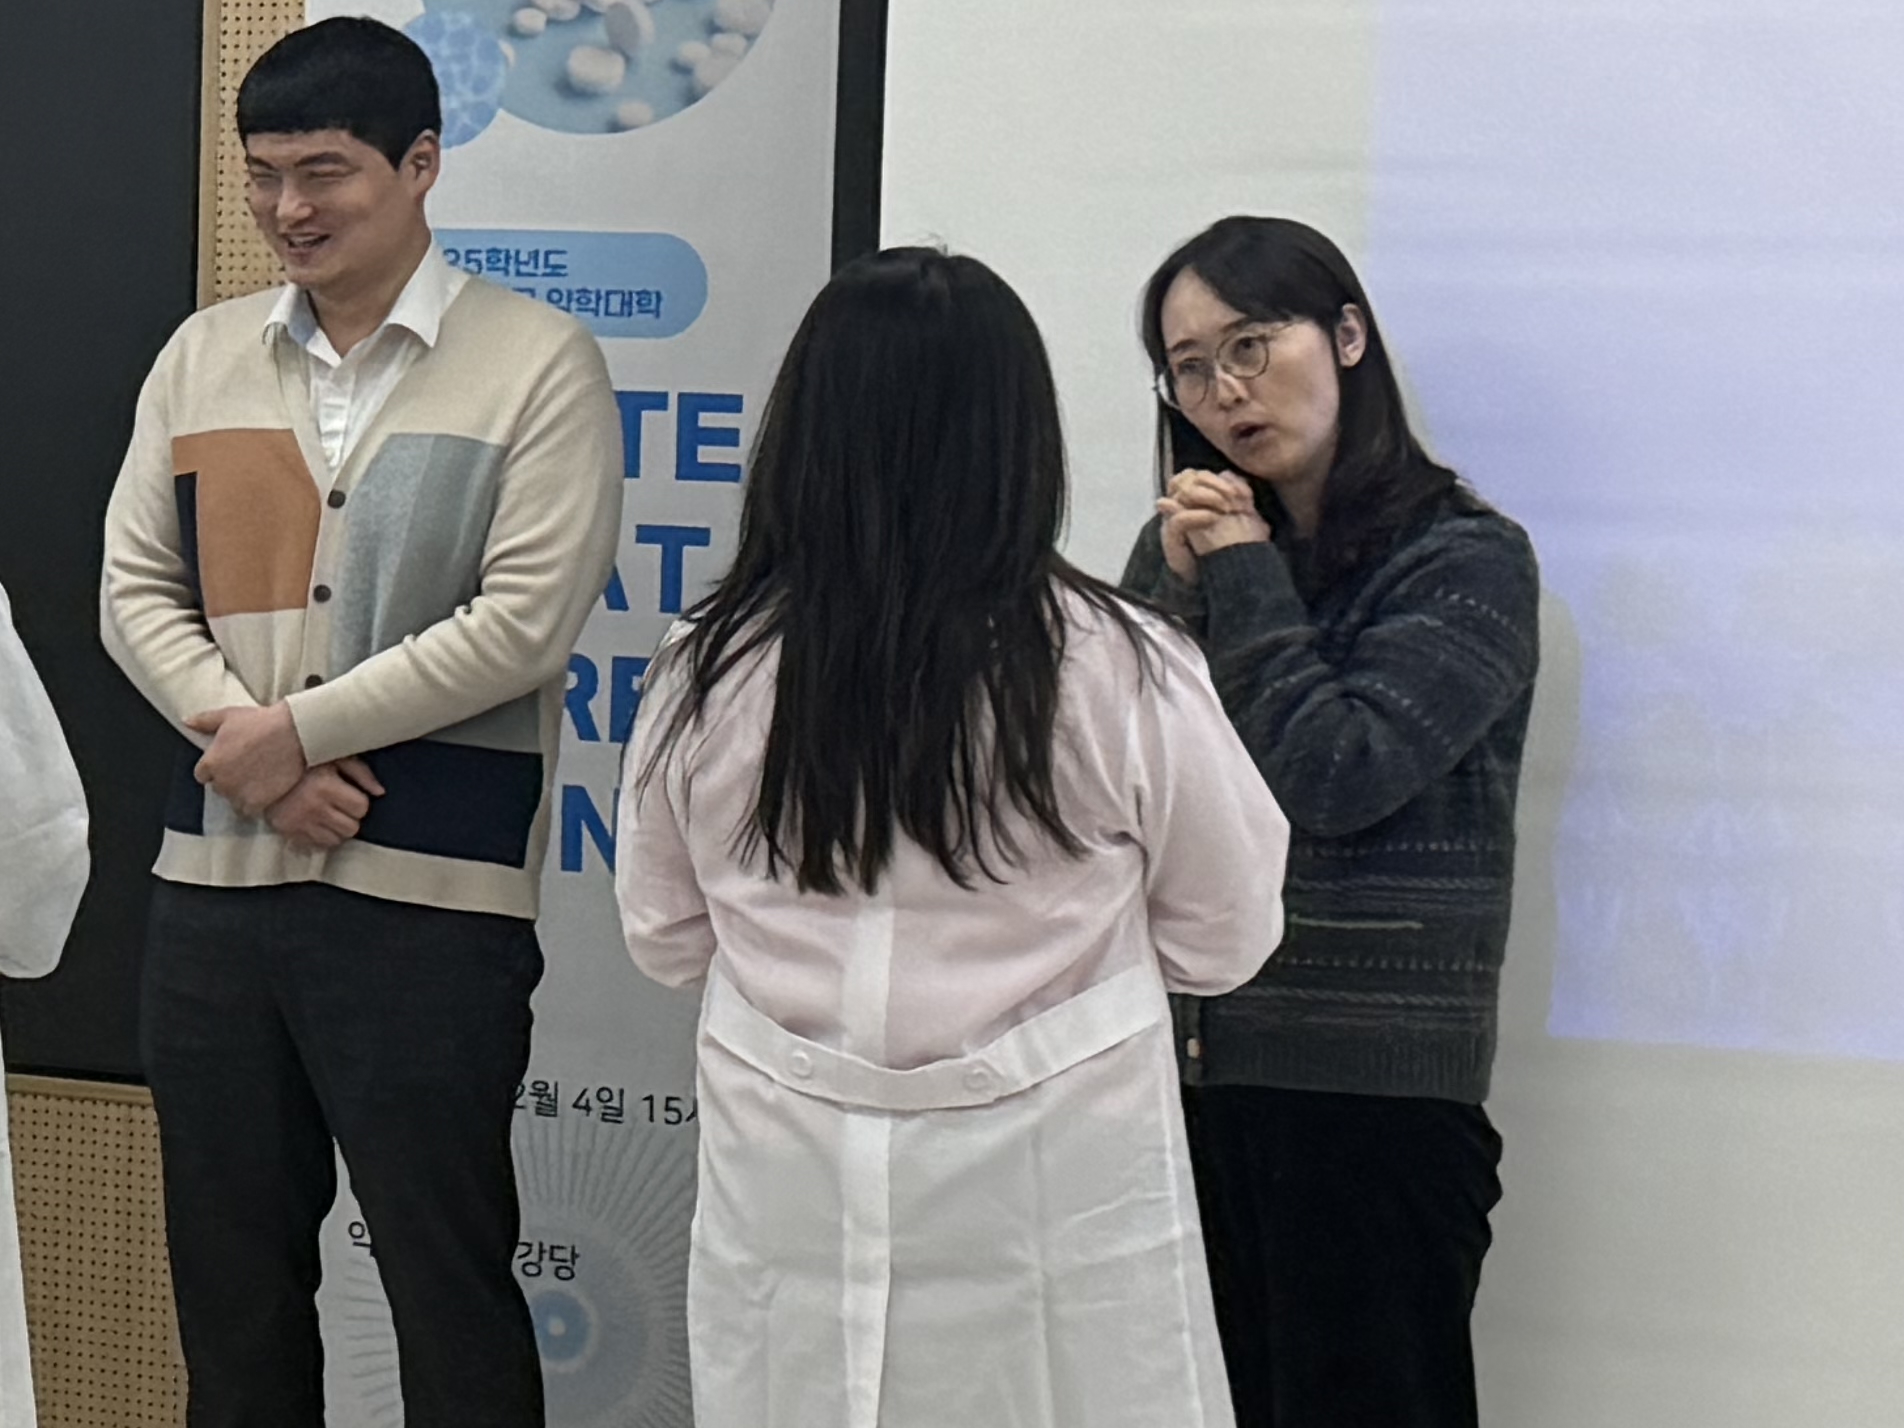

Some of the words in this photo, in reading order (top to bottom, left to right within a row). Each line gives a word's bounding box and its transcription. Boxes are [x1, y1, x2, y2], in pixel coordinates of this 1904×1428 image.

[443, 247, 568, 278] 25학년도
[514, 1080, 558, 1117] 2월
[572, 1087, 625, 1124] 4일
[642, 1094, 697, 1125] 15
[516, 1241, 580, 1281] 강당
